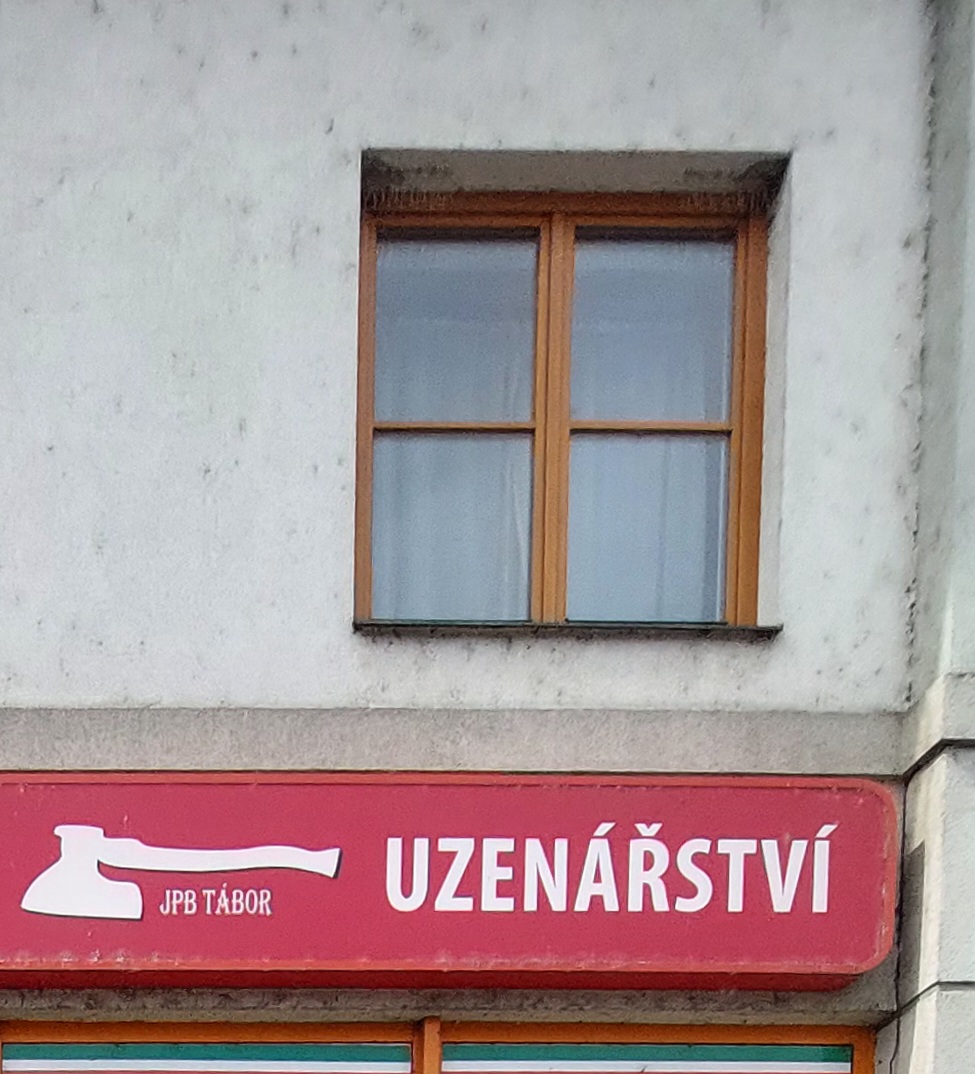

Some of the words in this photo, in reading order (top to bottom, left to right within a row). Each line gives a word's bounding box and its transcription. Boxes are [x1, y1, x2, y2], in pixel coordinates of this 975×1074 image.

[385, 821, 838, 913] UZENÁŘSTVÍ
[159, 889, 196, 915] JPB
[202, 883, 272, 915] TÁBOR
